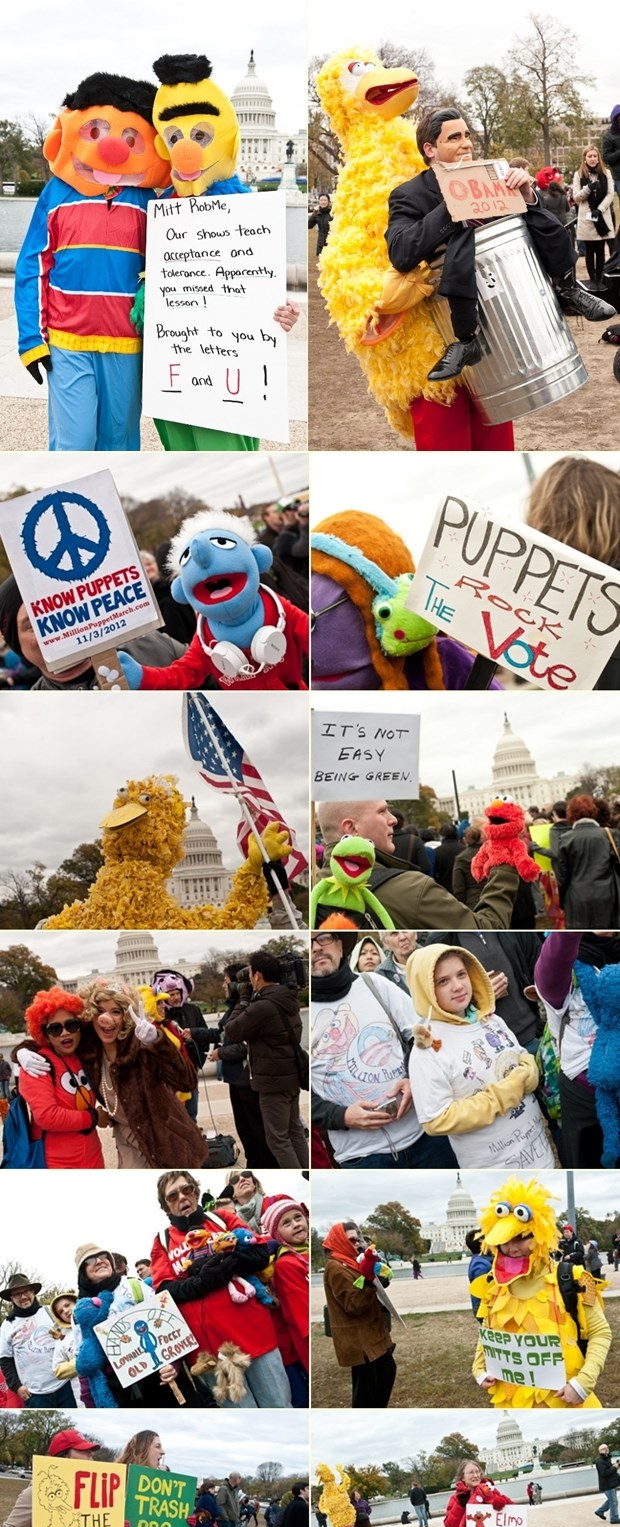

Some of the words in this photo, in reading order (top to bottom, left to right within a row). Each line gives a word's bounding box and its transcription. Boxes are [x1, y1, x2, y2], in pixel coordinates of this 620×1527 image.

[154, 202, 182, 219] Mitt
[189, 197, 231, 214] RobMe,
[470, 200, 510, 214] 2012
[166, 228, 188, 241] Our
[196, 228, 231, 241] shows
[234, 224, 271, 237] teach
[163, 248, 221, 263] acceptance
[230, 247, 254, 259] and
[160, 267, 211, 279] tolerance.
[159, 285, 177, 297] you
[182, 284, 214, 293] missed
[221, 284, 247, 294] that
[156, 323, 199, 342] Brought
[207, 326, 223, 338] to
[231, 331, 255, 343] you
[260, 329, 277, 348] by
[171, 343, 192, 354] the
[199, 344, 239, 358] letters
[169, 363, 181, 388] F
[191, 375, 213, 387] and
[226, 368, 240, 395] U
[433, 495, 620, 636] PUPPETS
[30, 588, 75, 618] KNOW
[76, 565, 140, 601] PUPPETS
[425, 575, 456, 623] THE
[36, 602, 91, 638] KNOW
[90, 581, 147, 617] PEACE
[454, 575, 564, 641] ROCK
[43, 601, 151, 646] www.MillionPuppetMarch.com
[76, 619, 127, 645] 11/3/2012
[481, 611, 577, 690] Vote
[321, 723, 366, 738] IT'S
[374, 728, 410, 740] NOT
[337, 747, 385, 762] EASY
[314, 770, 359, 782] BEING
[365, 771, 412, 783] GREEN.
[106, 1318, 132, 1356] HANDS
[147, 1308, 175, 1323] OFF
[513, 1334, 561, 1347] YOUR
[161, 1333, 198, 1361] GROVER!
[526, 1351, 563, 1366] OFF
[128, 1361, 148, 1378] OLD
[138, 1474, 187, 1498] DON'T
[134, 1494, 189, 1519] TRASH
[496, 1512, 524, 1527] Elmo
